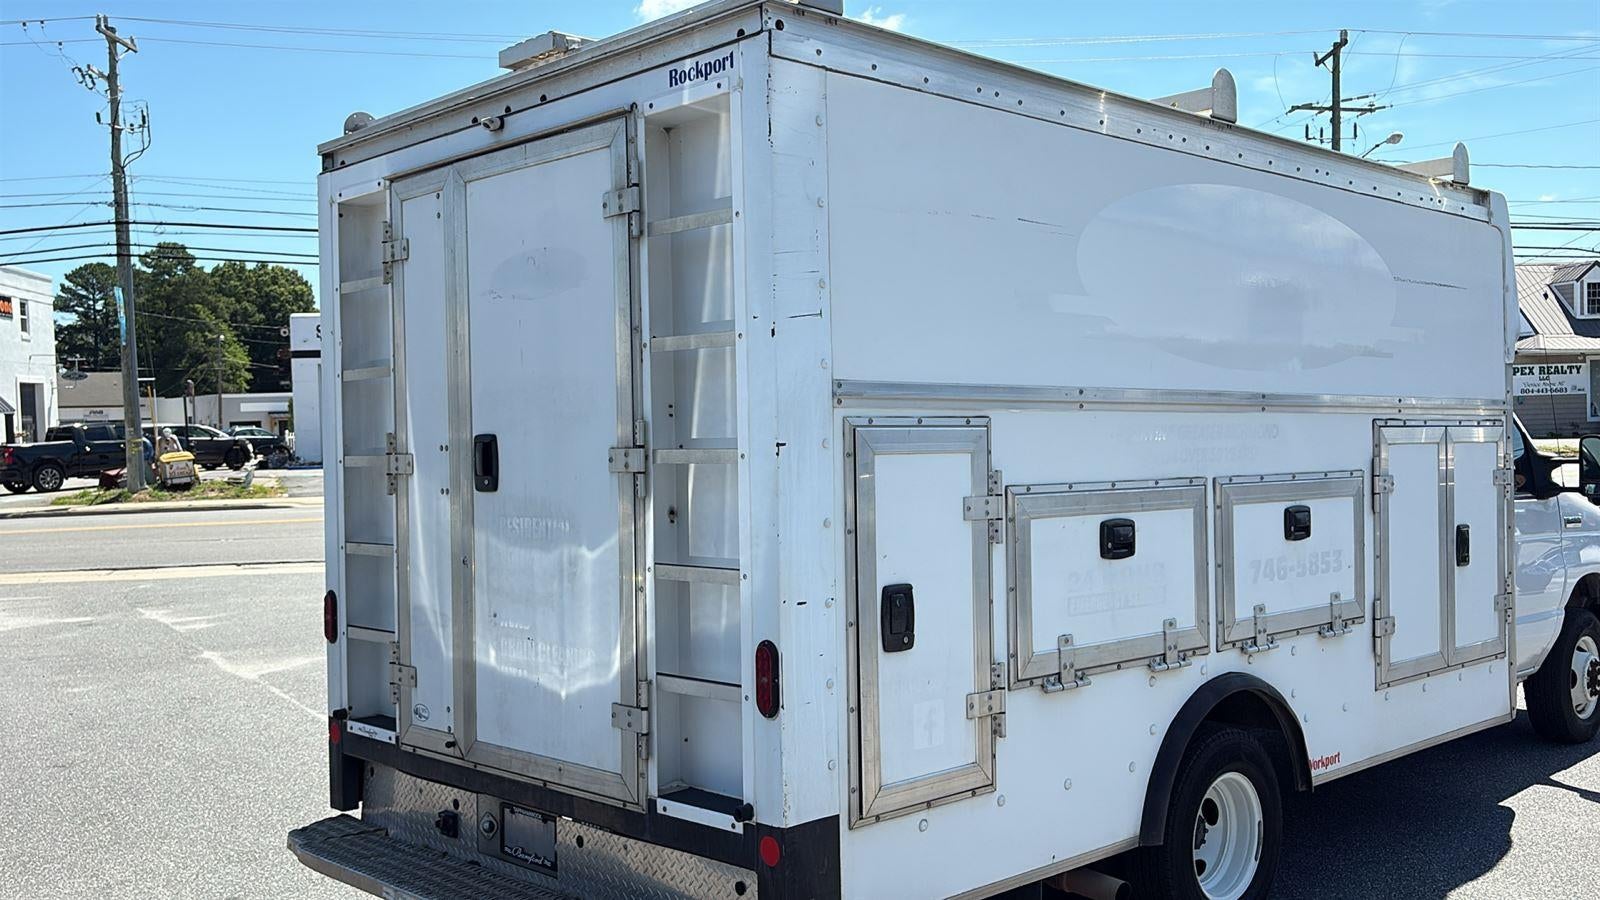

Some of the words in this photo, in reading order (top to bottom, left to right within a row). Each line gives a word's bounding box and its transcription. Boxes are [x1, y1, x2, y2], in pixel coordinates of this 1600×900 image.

[669, 50, 734, 88] Rockport
[1538, 364, 1582, 375] REALTY
[1248, 549, 1344, 584] 746-5853
